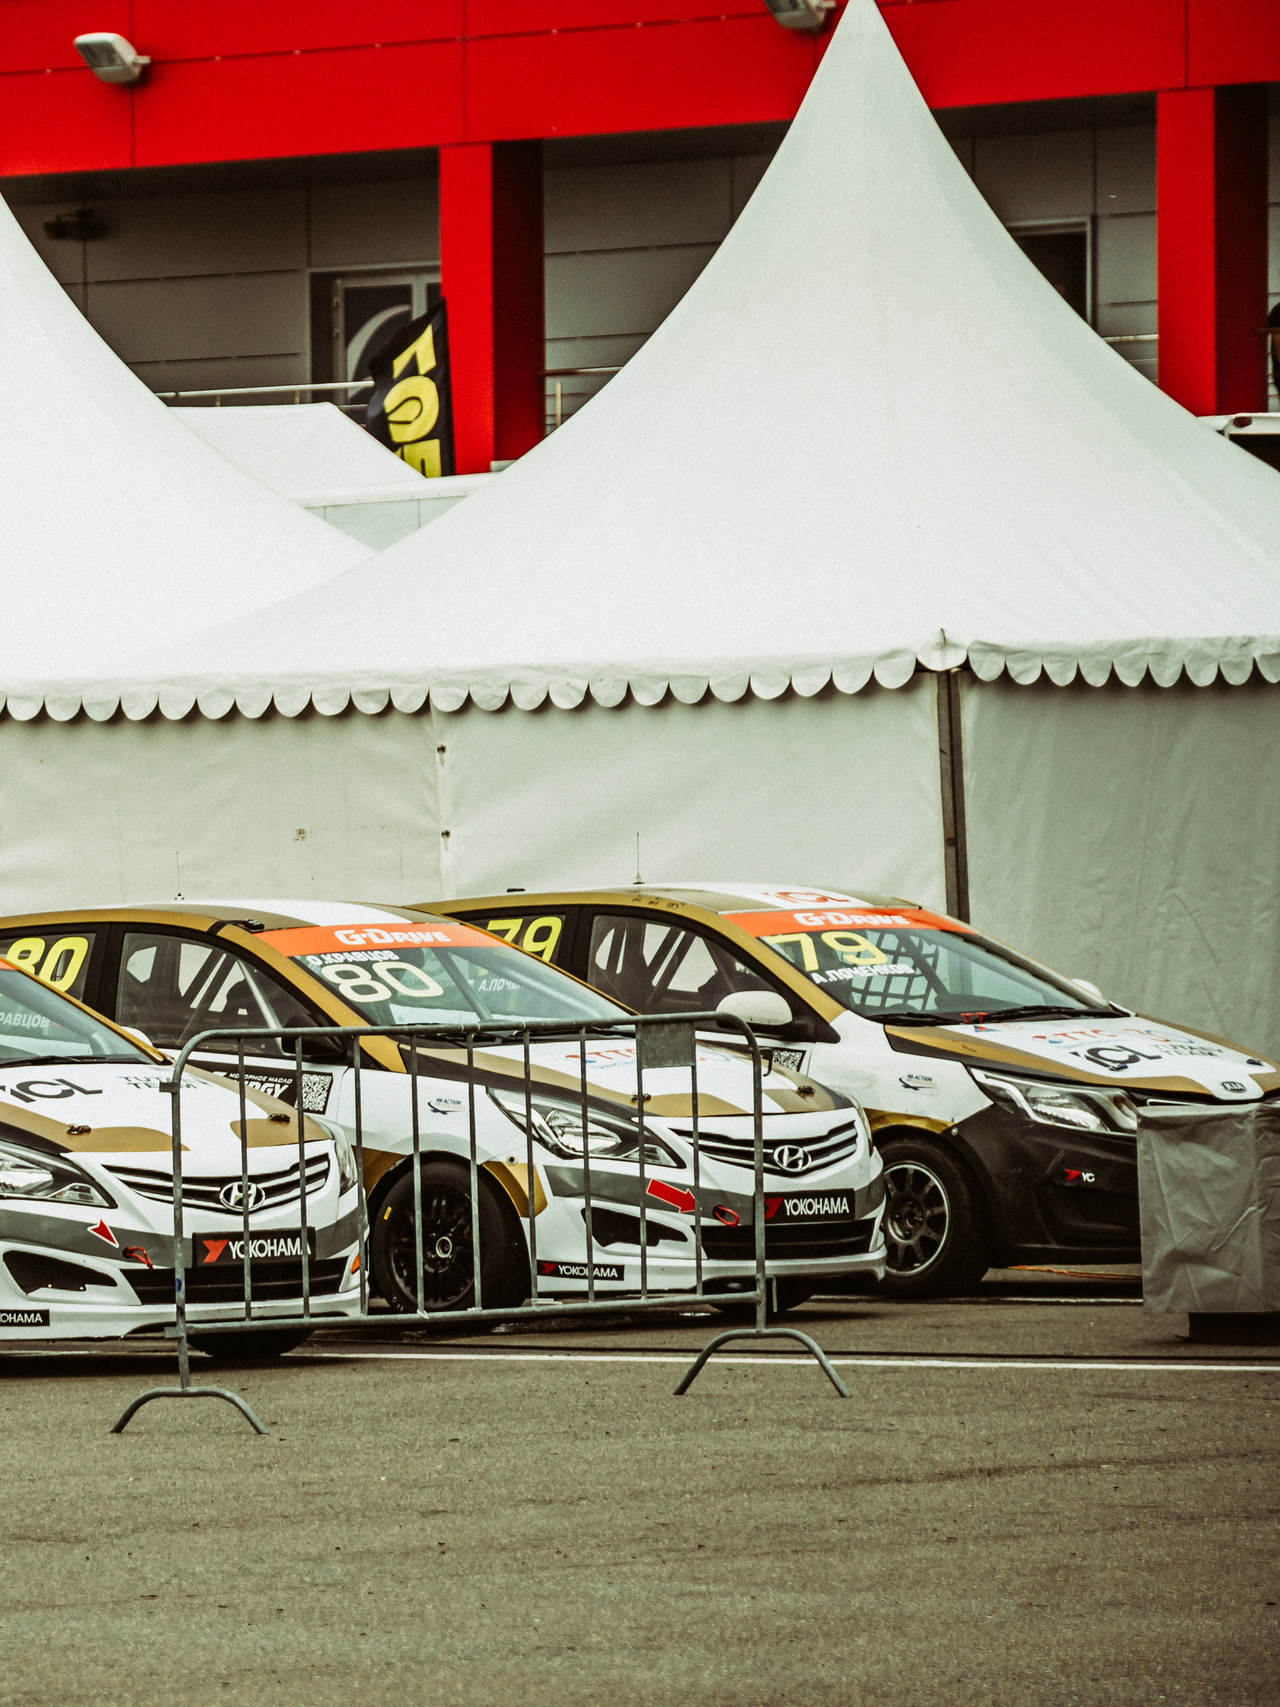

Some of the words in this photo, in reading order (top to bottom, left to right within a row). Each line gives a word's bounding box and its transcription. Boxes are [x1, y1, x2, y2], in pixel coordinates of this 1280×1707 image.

[486, 916, 563, 963] 79
[765, 931, 888, 972] 79
[6, 936, 89, 993] 80
[321, 961, 444, 1003] 80
[1223, 1081, 1245, 1091] KIA
[783, 1196, 850, 1217] YOKOHAMA
